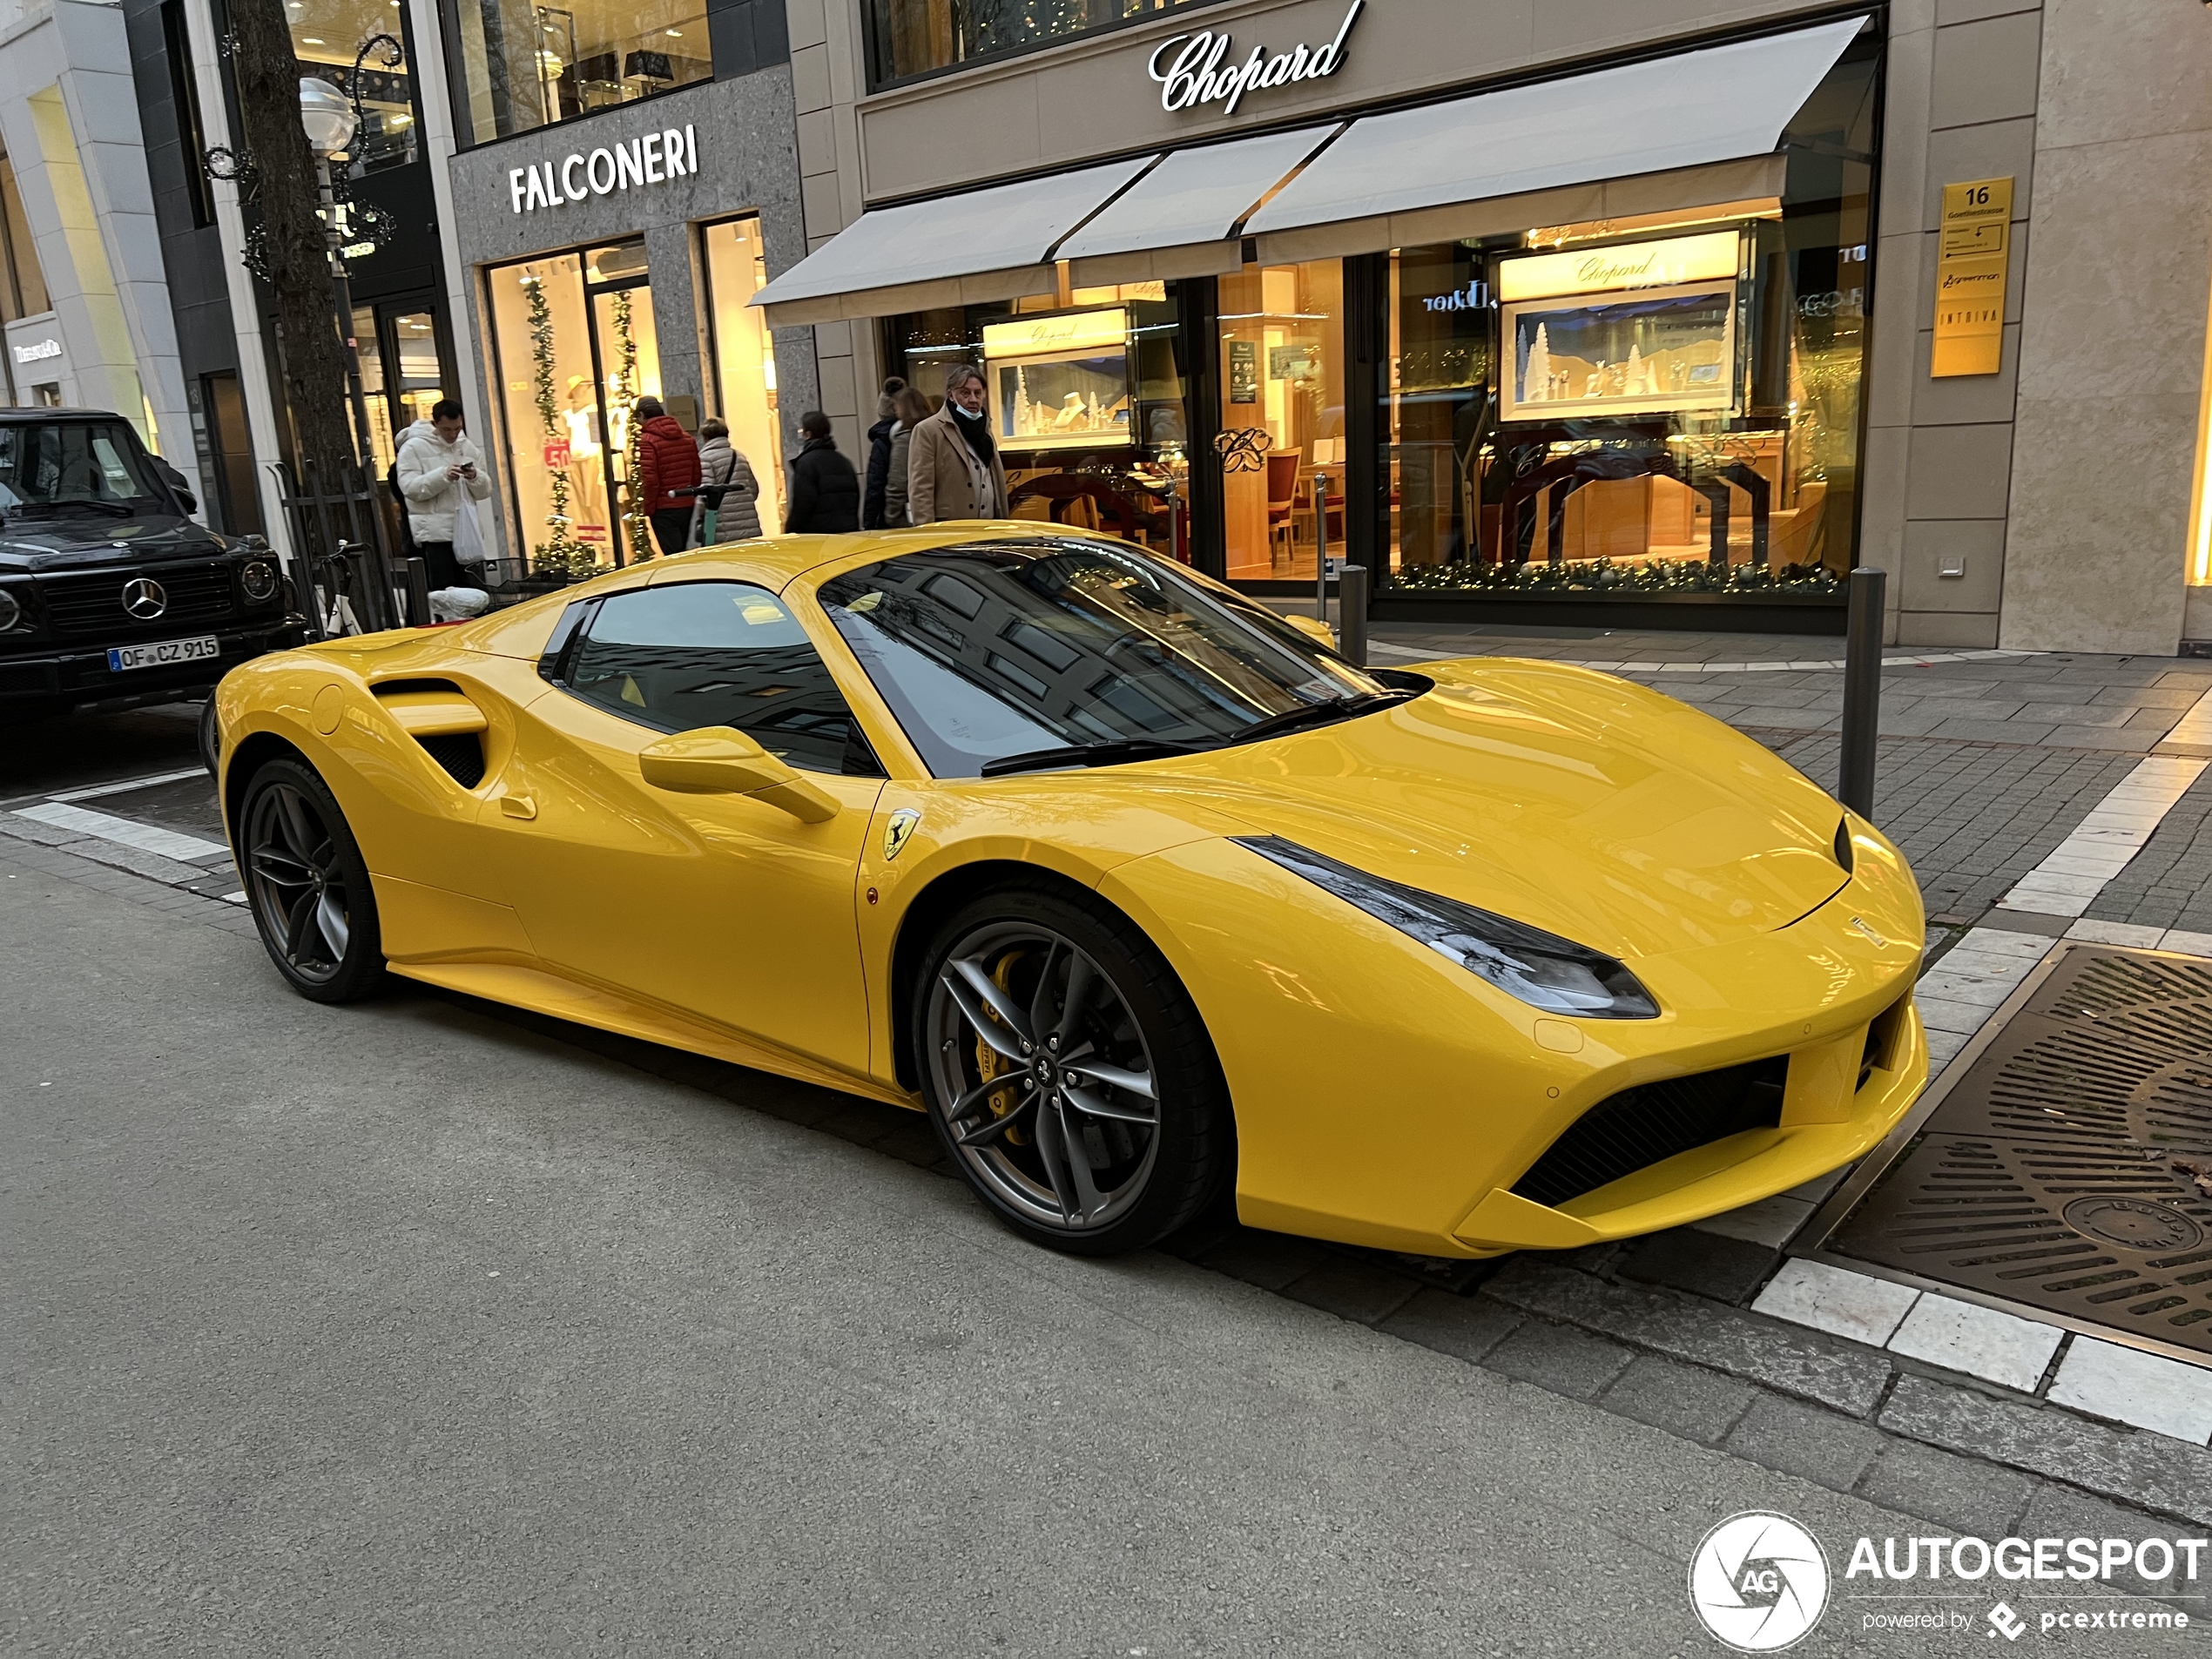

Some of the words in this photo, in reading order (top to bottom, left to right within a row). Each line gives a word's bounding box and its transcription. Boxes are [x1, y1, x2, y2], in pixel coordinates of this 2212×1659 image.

[1148, 0, 1362, 114] Chopard
[509, 124, 698, 213] FALCONERI
[1966, 185, 1989, 206] 16
[1576, 252, 1656, 284] Chopard
[122, 649, 144, 667] OF
[158, 644, 181, 662] CZ
[184, 639, 216, 658] 915
